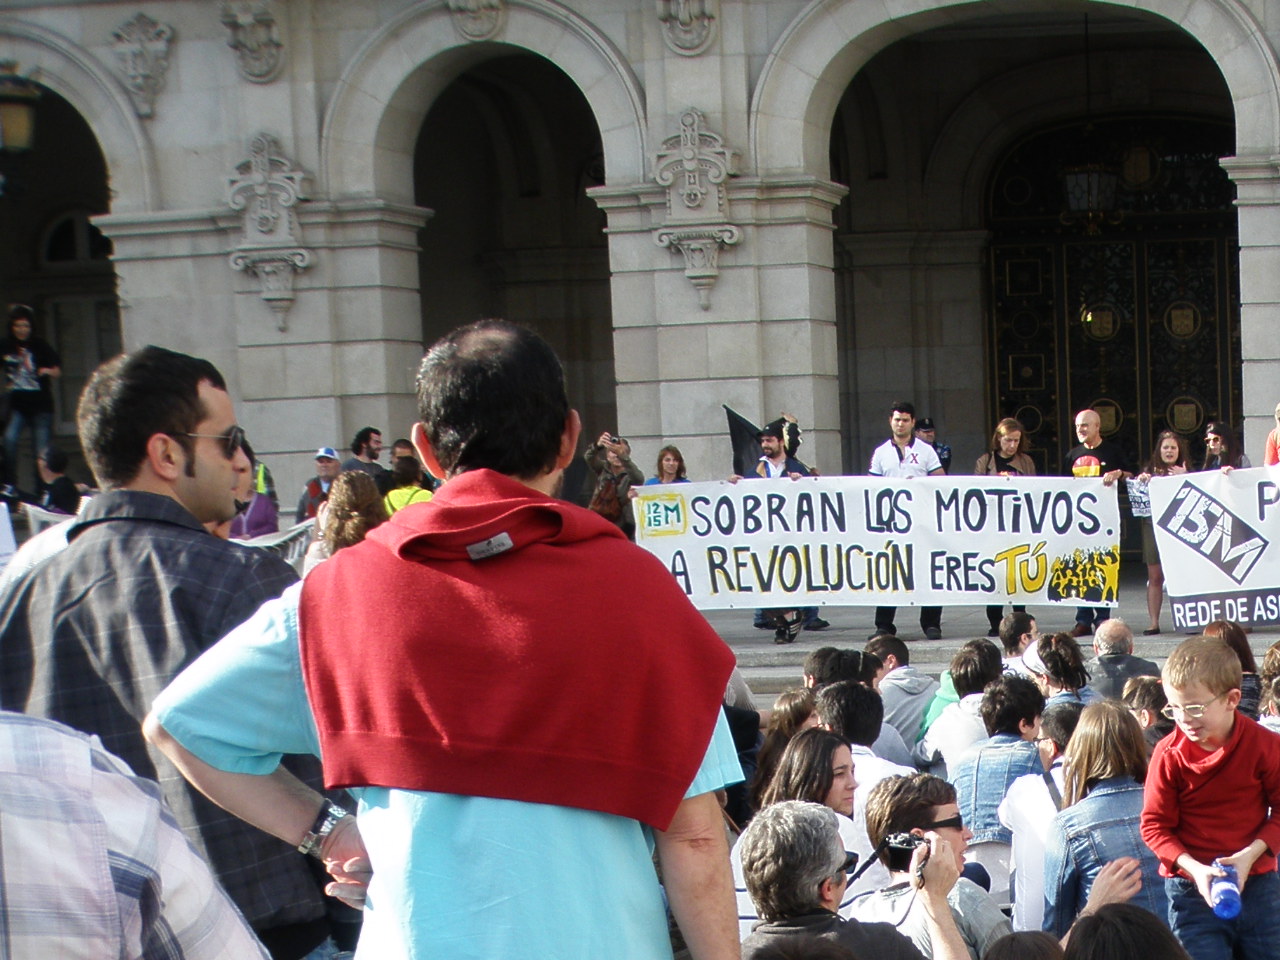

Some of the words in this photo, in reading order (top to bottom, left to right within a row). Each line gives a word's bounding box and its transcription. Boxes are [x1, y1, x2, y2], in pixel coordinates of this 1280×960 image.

[691, 492, 846, 537] SOBRAN
[864, 487, 913, 534] LOS
[671, 550, 693, 595] A
[930, 551, 996, 593] ERES
[994, 541, 1048, 595] TÚ
[1225, 598, 1250, 622] DE
